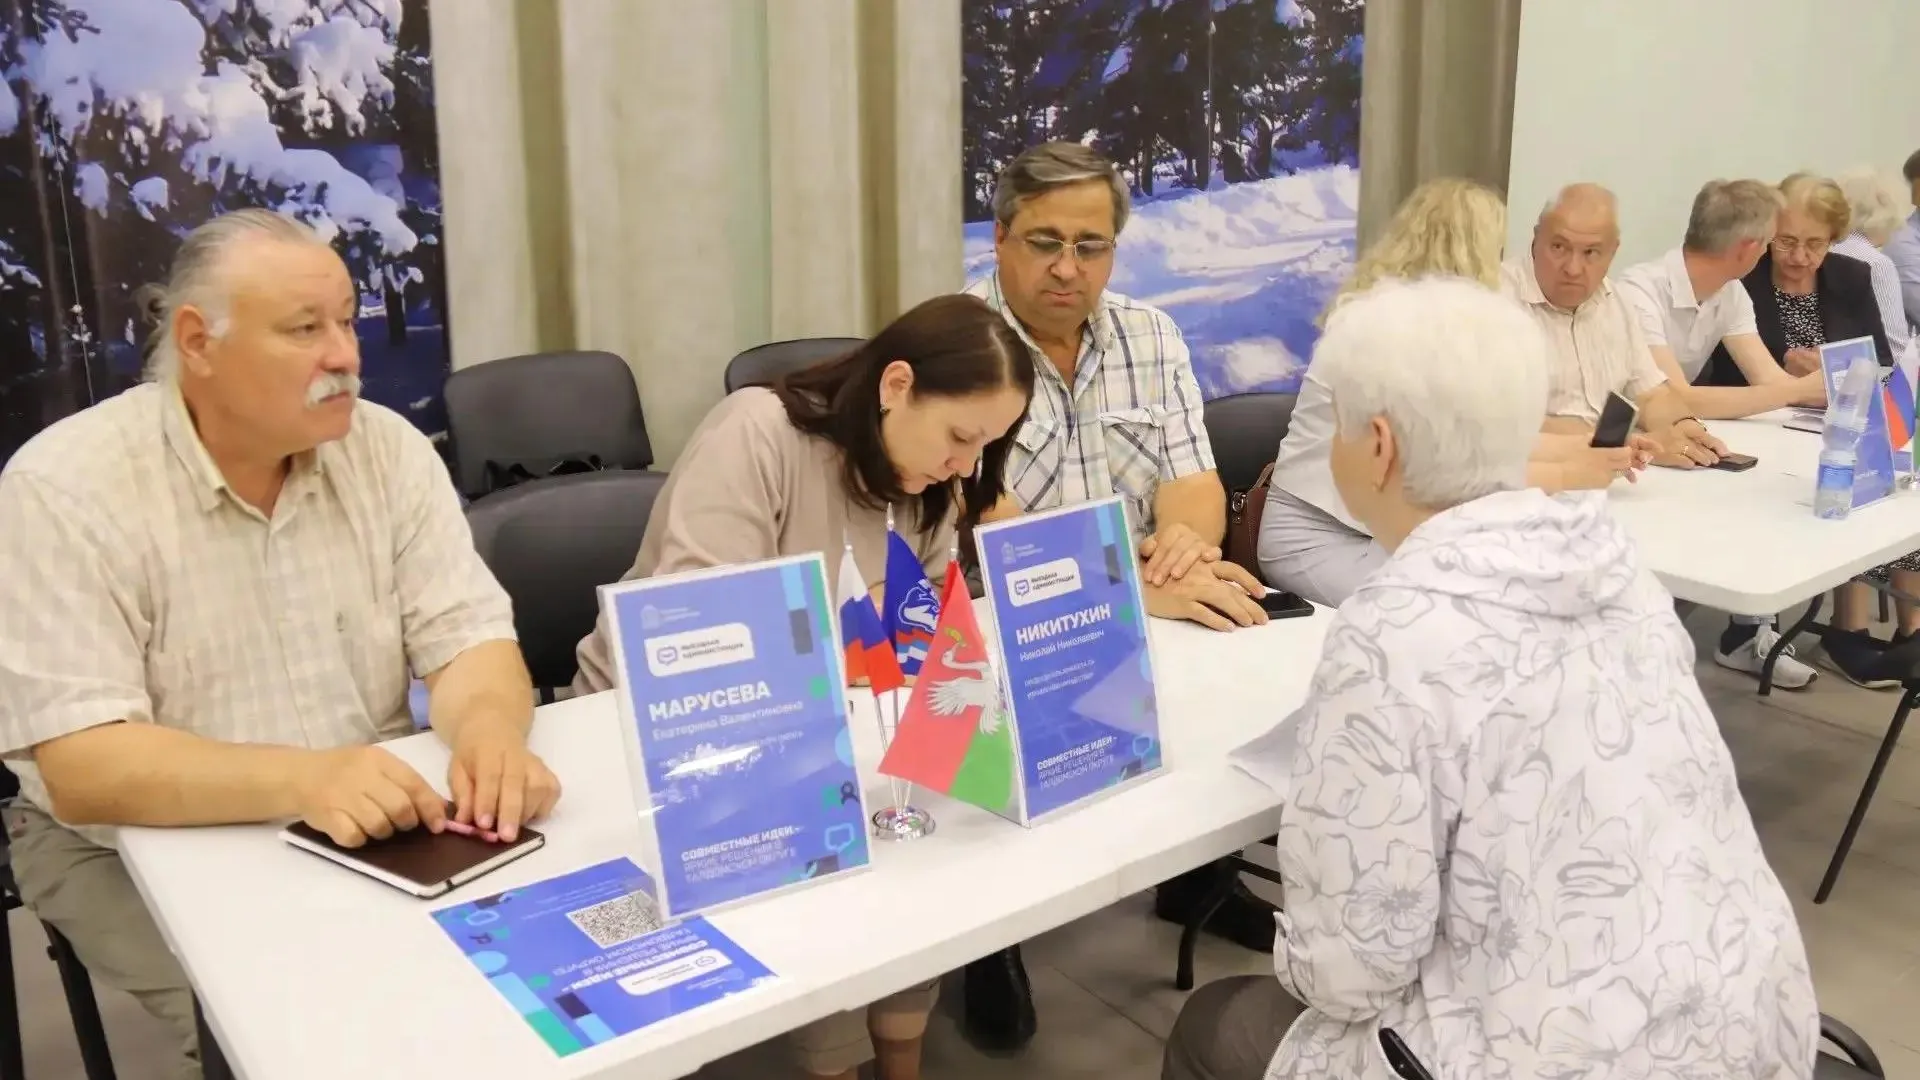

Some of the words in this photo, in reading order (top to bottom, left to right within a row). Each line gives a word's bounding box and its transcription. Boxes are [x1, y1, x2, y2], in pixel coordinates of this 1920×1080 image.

[1015, 603, 1111, 646] НИКИТУХИН
[1019, 641, 1057, 663] Николай
[1056, 627, 1104, 650] Николаевич
[647, 679, 772, 722] МАРУСЕВА
[651, 716, 718, 742] Екатерина
[718, 698, 804, 727] Валентиновна
[1036, 743, 1090, 772] СОВМЕСТНЫЕ
[1090, 734, 1113, 751] ИДЕИ
[680, 832, 760, 863] СОВМЕСТНЫЕ
[760, 824, 794, 842] ИДЕИ
[610, 938, 710, 976] СОВМЕСТНЫЕ
[568, 970, 615, 990] ИДЕИ
